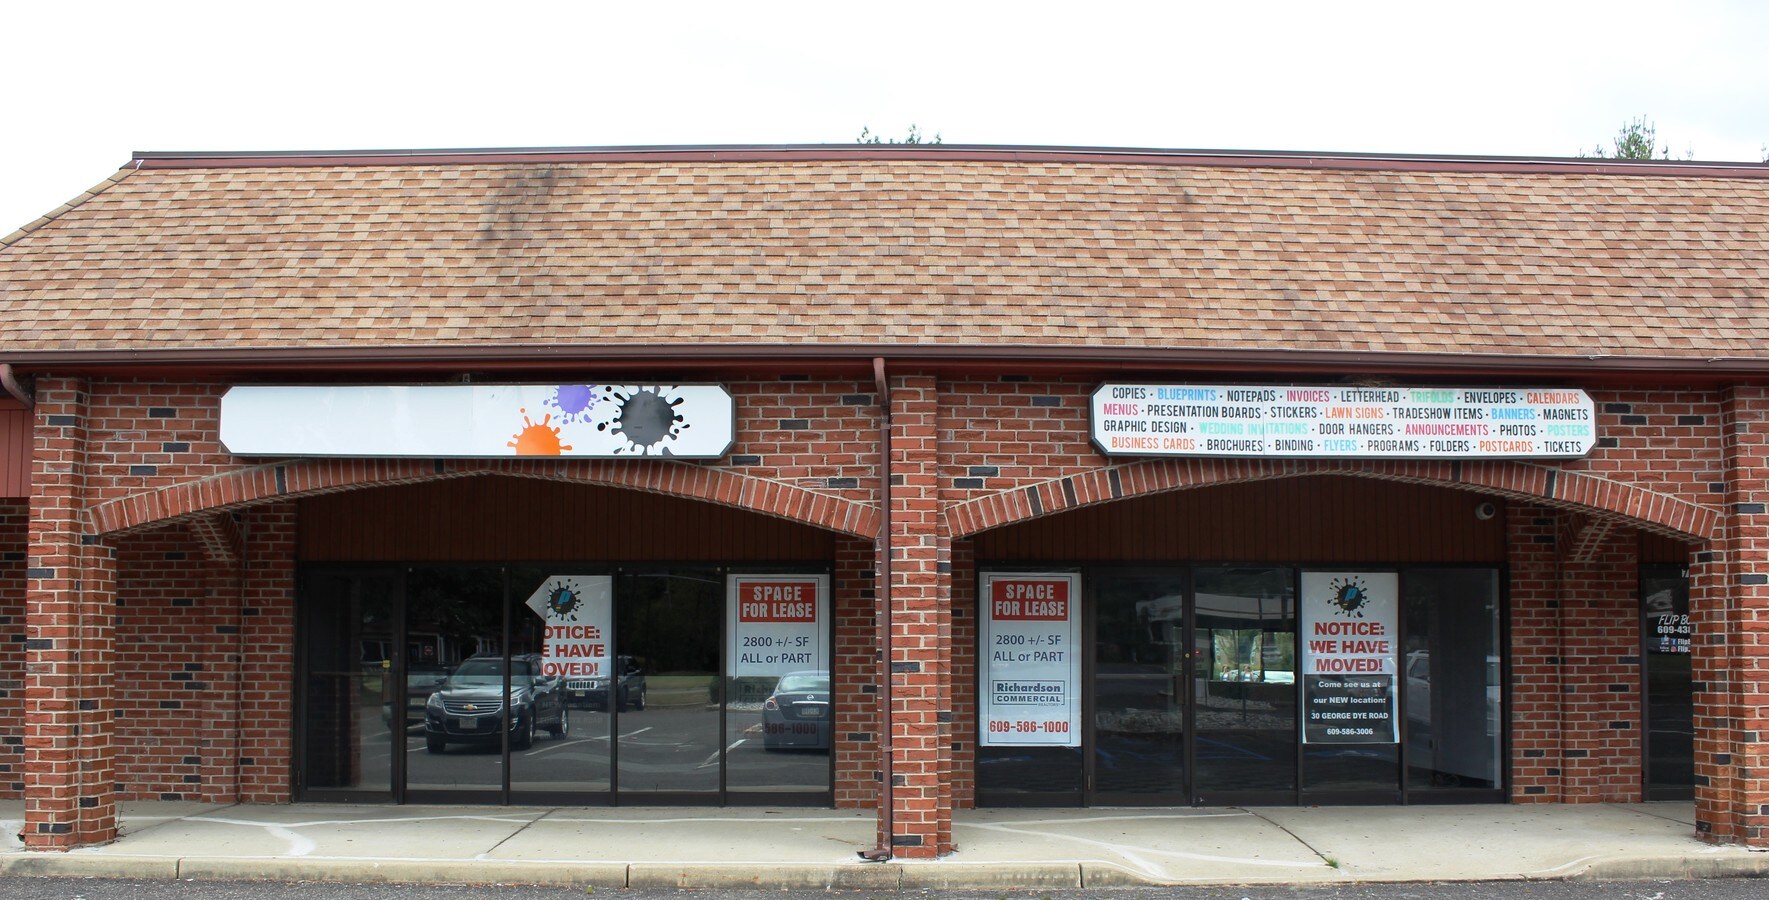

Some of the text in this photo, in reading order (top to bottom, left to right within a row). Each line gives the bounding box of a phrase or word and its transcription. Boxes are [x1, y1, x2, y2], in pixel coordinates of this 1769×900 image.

[1112, 387, 1580, 404] COPIES BLUEPRINTS NOTEPADS INVOICES LETTERHEAD TRIFOLDS ENVELOPES CALENDARS
[1103, 403, 1588, 421] MENUS PRESENTATION BOARDS STICKERS LAWN SIGNS TRADESHOW ITEMS BANNERS MAGNETS
[1103, 420, 1590, 437] GRAPHIC DESIGN WEDDING INVITATIONS DOOR HANGERS ANNOUNCEMENTS PHOTOS POSTERS
[1111, 436, 1581, 453] BUSINESS CARDS BROCHURES BINDING FLYERS PROGRAMS FOLDERS POSTCARDS TICKETS
[753, 586, 802, 601] SPACE
[1006, 584, 1054, 599] SPACE
[742, 603, 812, 618] FOR LEASE
[995, 601, 1065, 616] FOR LEASE
[1658, 614, 1680, 625] FLIP
[1314, 622, 1385, 635] NOTICE:
[743, 636, 772, 647] 2800
[795, 636, 809, 647] SF
[996, 634, 1025, 645] 2800
[1048, 634, 1061, 645] SF
[556, 644, 605, 657] HAVE
[1309, 640, 1389, 653] WE HAVE
[741, 653, 812, 664] ALL or PART
[993, 651, 1064, 662] ALL or PART
[540, 662, 599, 676] OVED!
[1316, 658, 1383, 672] MOVED!
[997, 683, 1061, 692] Richardson
[741, 722, 817, 735] -586-1000
[989, 720, 1069, 733] 609-586-1000
